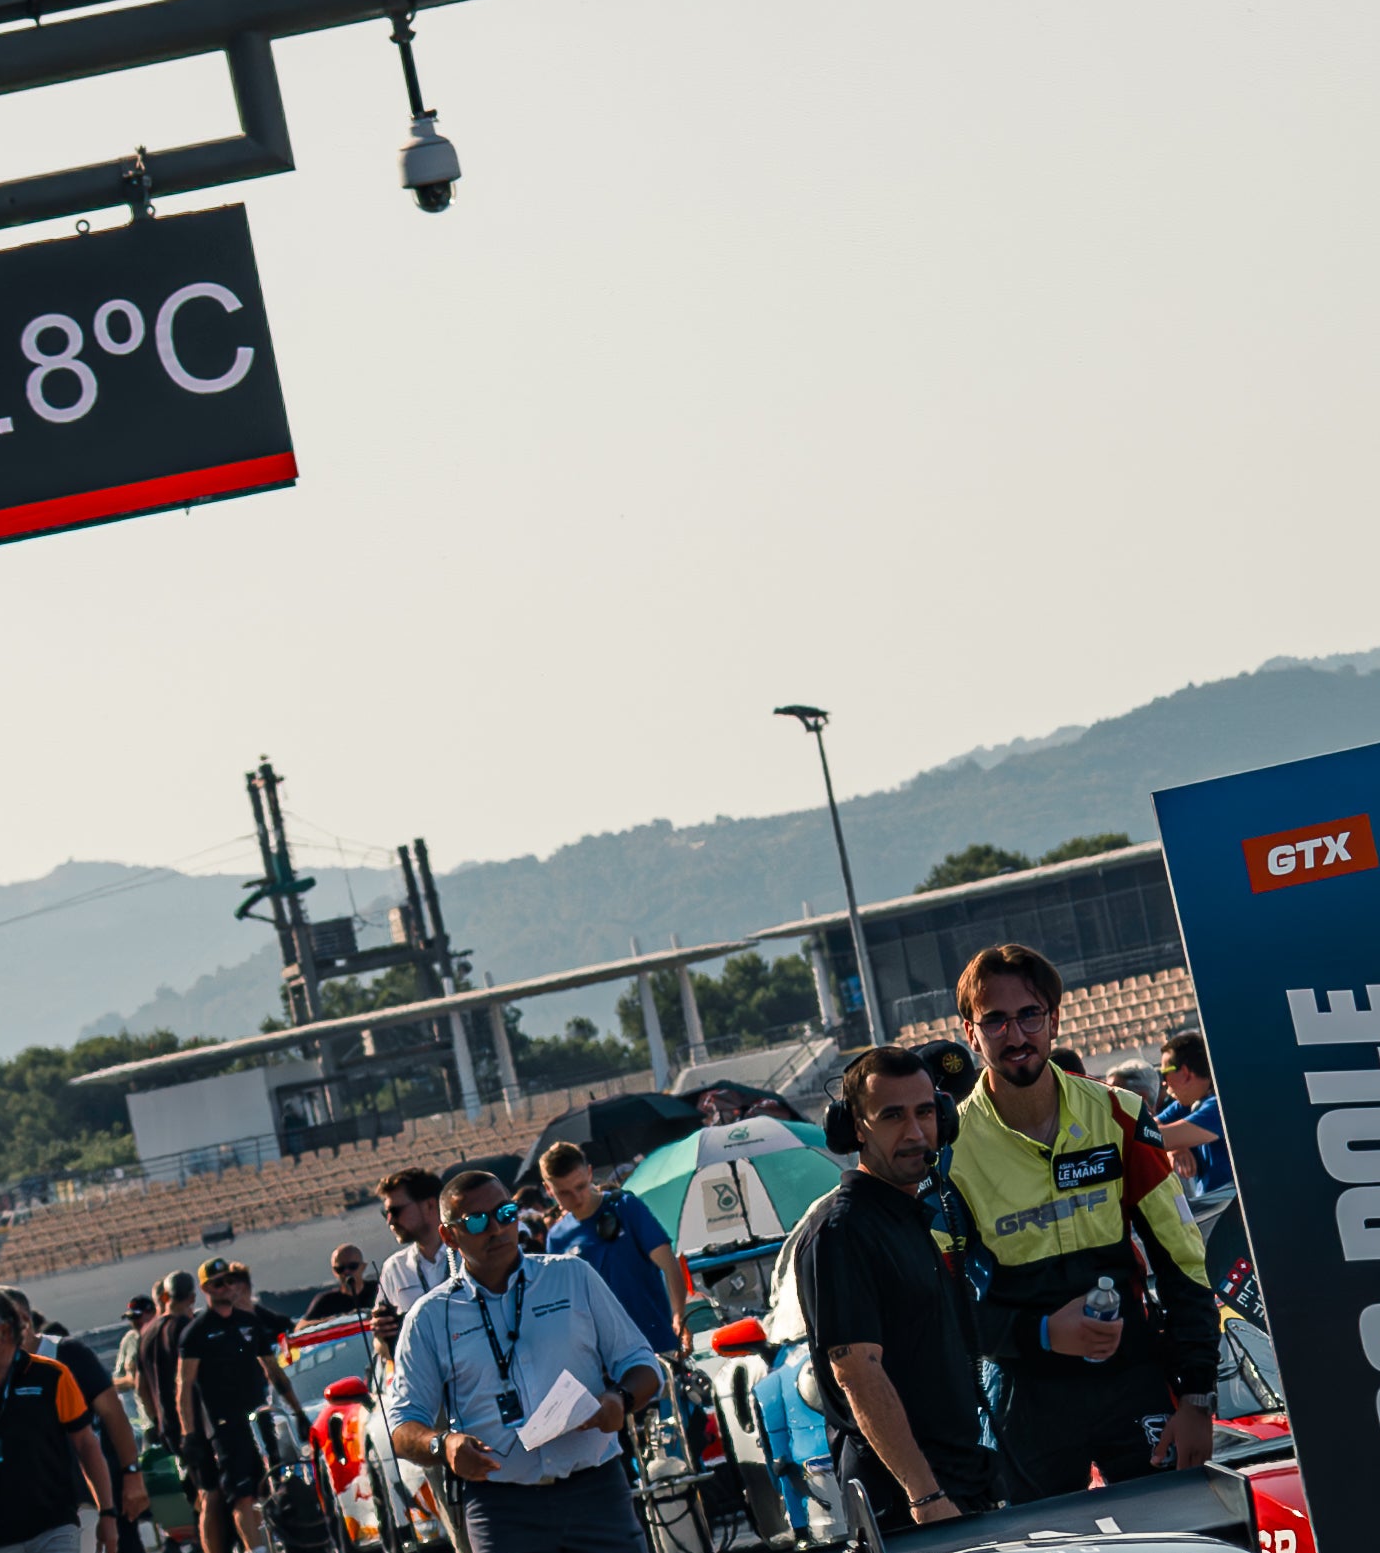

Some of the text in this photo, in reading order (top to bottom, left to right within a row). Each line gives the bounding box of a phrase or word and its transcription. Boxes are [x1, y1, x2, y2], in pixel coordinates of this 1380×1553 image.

[1267, 832, 1351, 876] GTX
[1058, 1162, 1105, 1181] LE MANS
